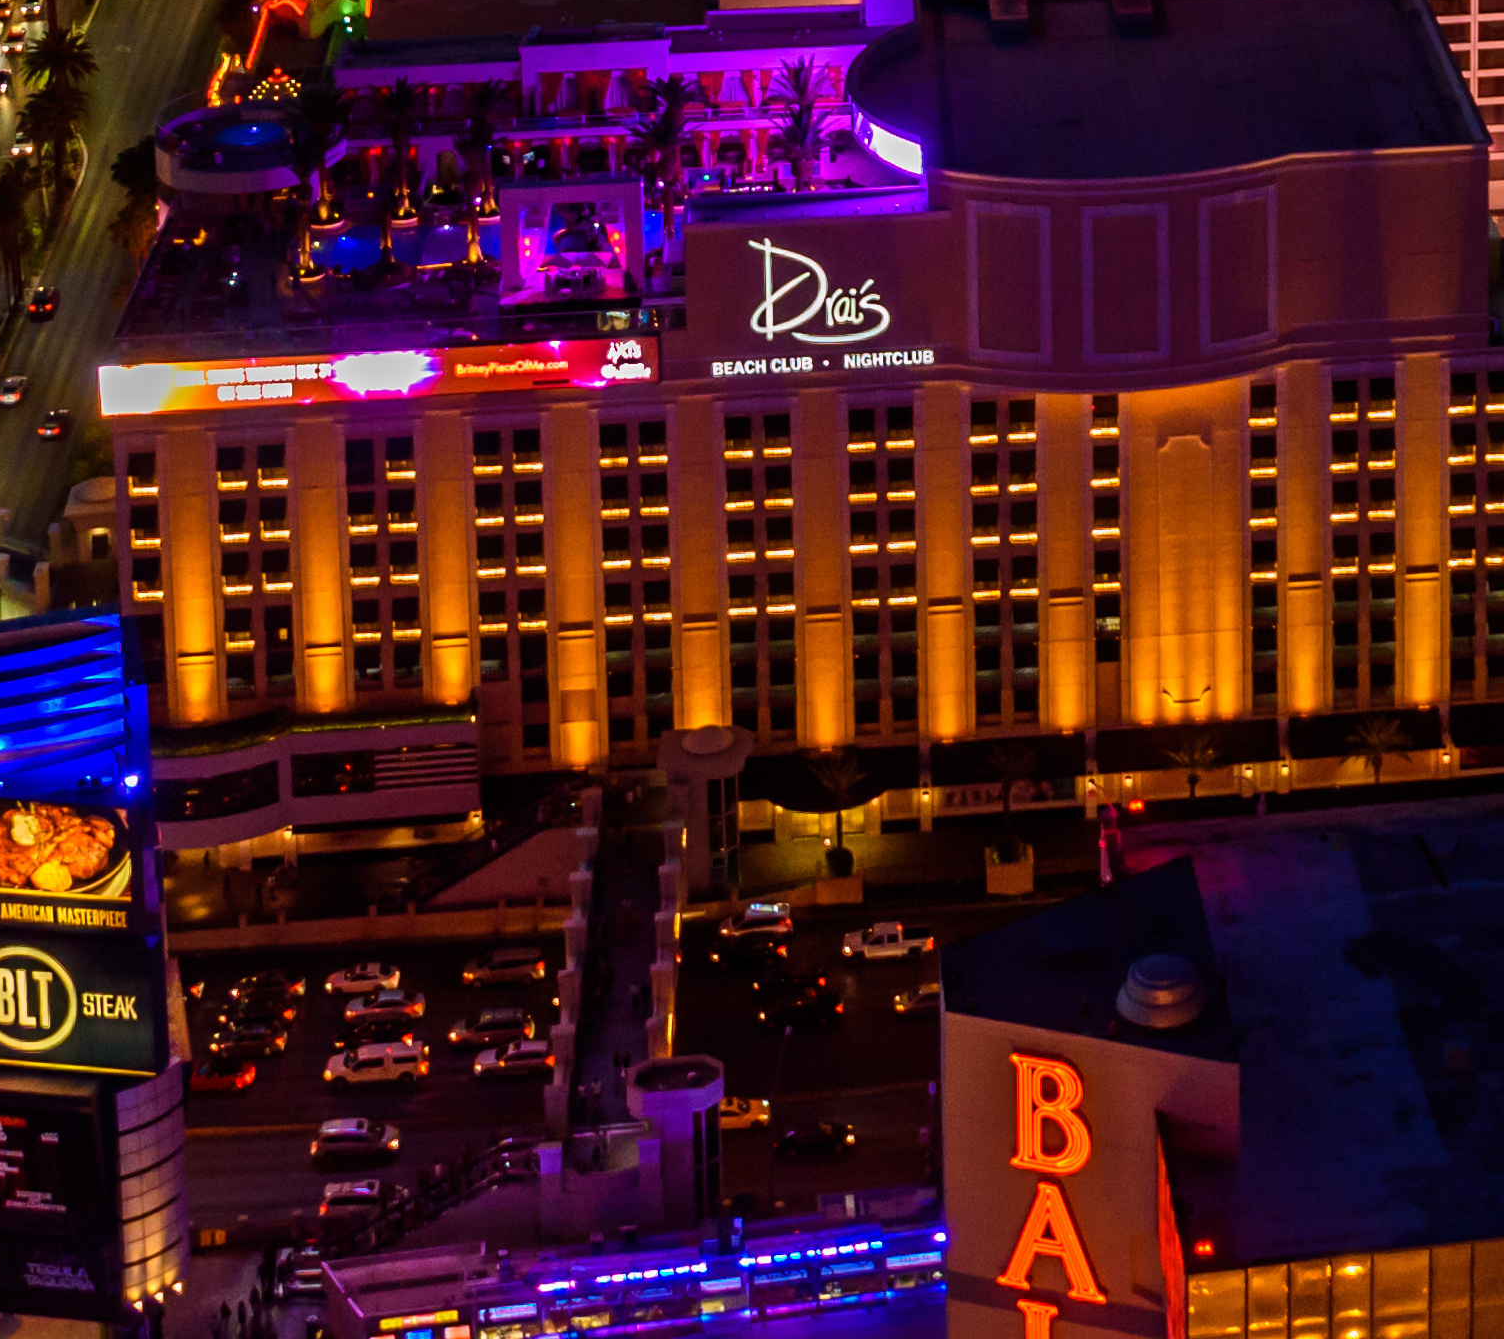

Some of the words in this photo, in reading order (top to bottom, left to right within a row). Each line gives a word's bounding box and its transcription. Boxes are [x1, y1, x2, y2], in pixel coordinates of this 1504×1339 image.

[748, 238, 891, 344] Drai's
[712, 360, 767, 377] BEACH
[769, 356, 813, 373] CLUB
[843, 350, 934, 369] NIGHTCLUB
[0, 902, 54, 923] AMERICAN
[57, 906, 128, 928] MASTERPIECE
[82, 992, 137, 1020] STEAK
